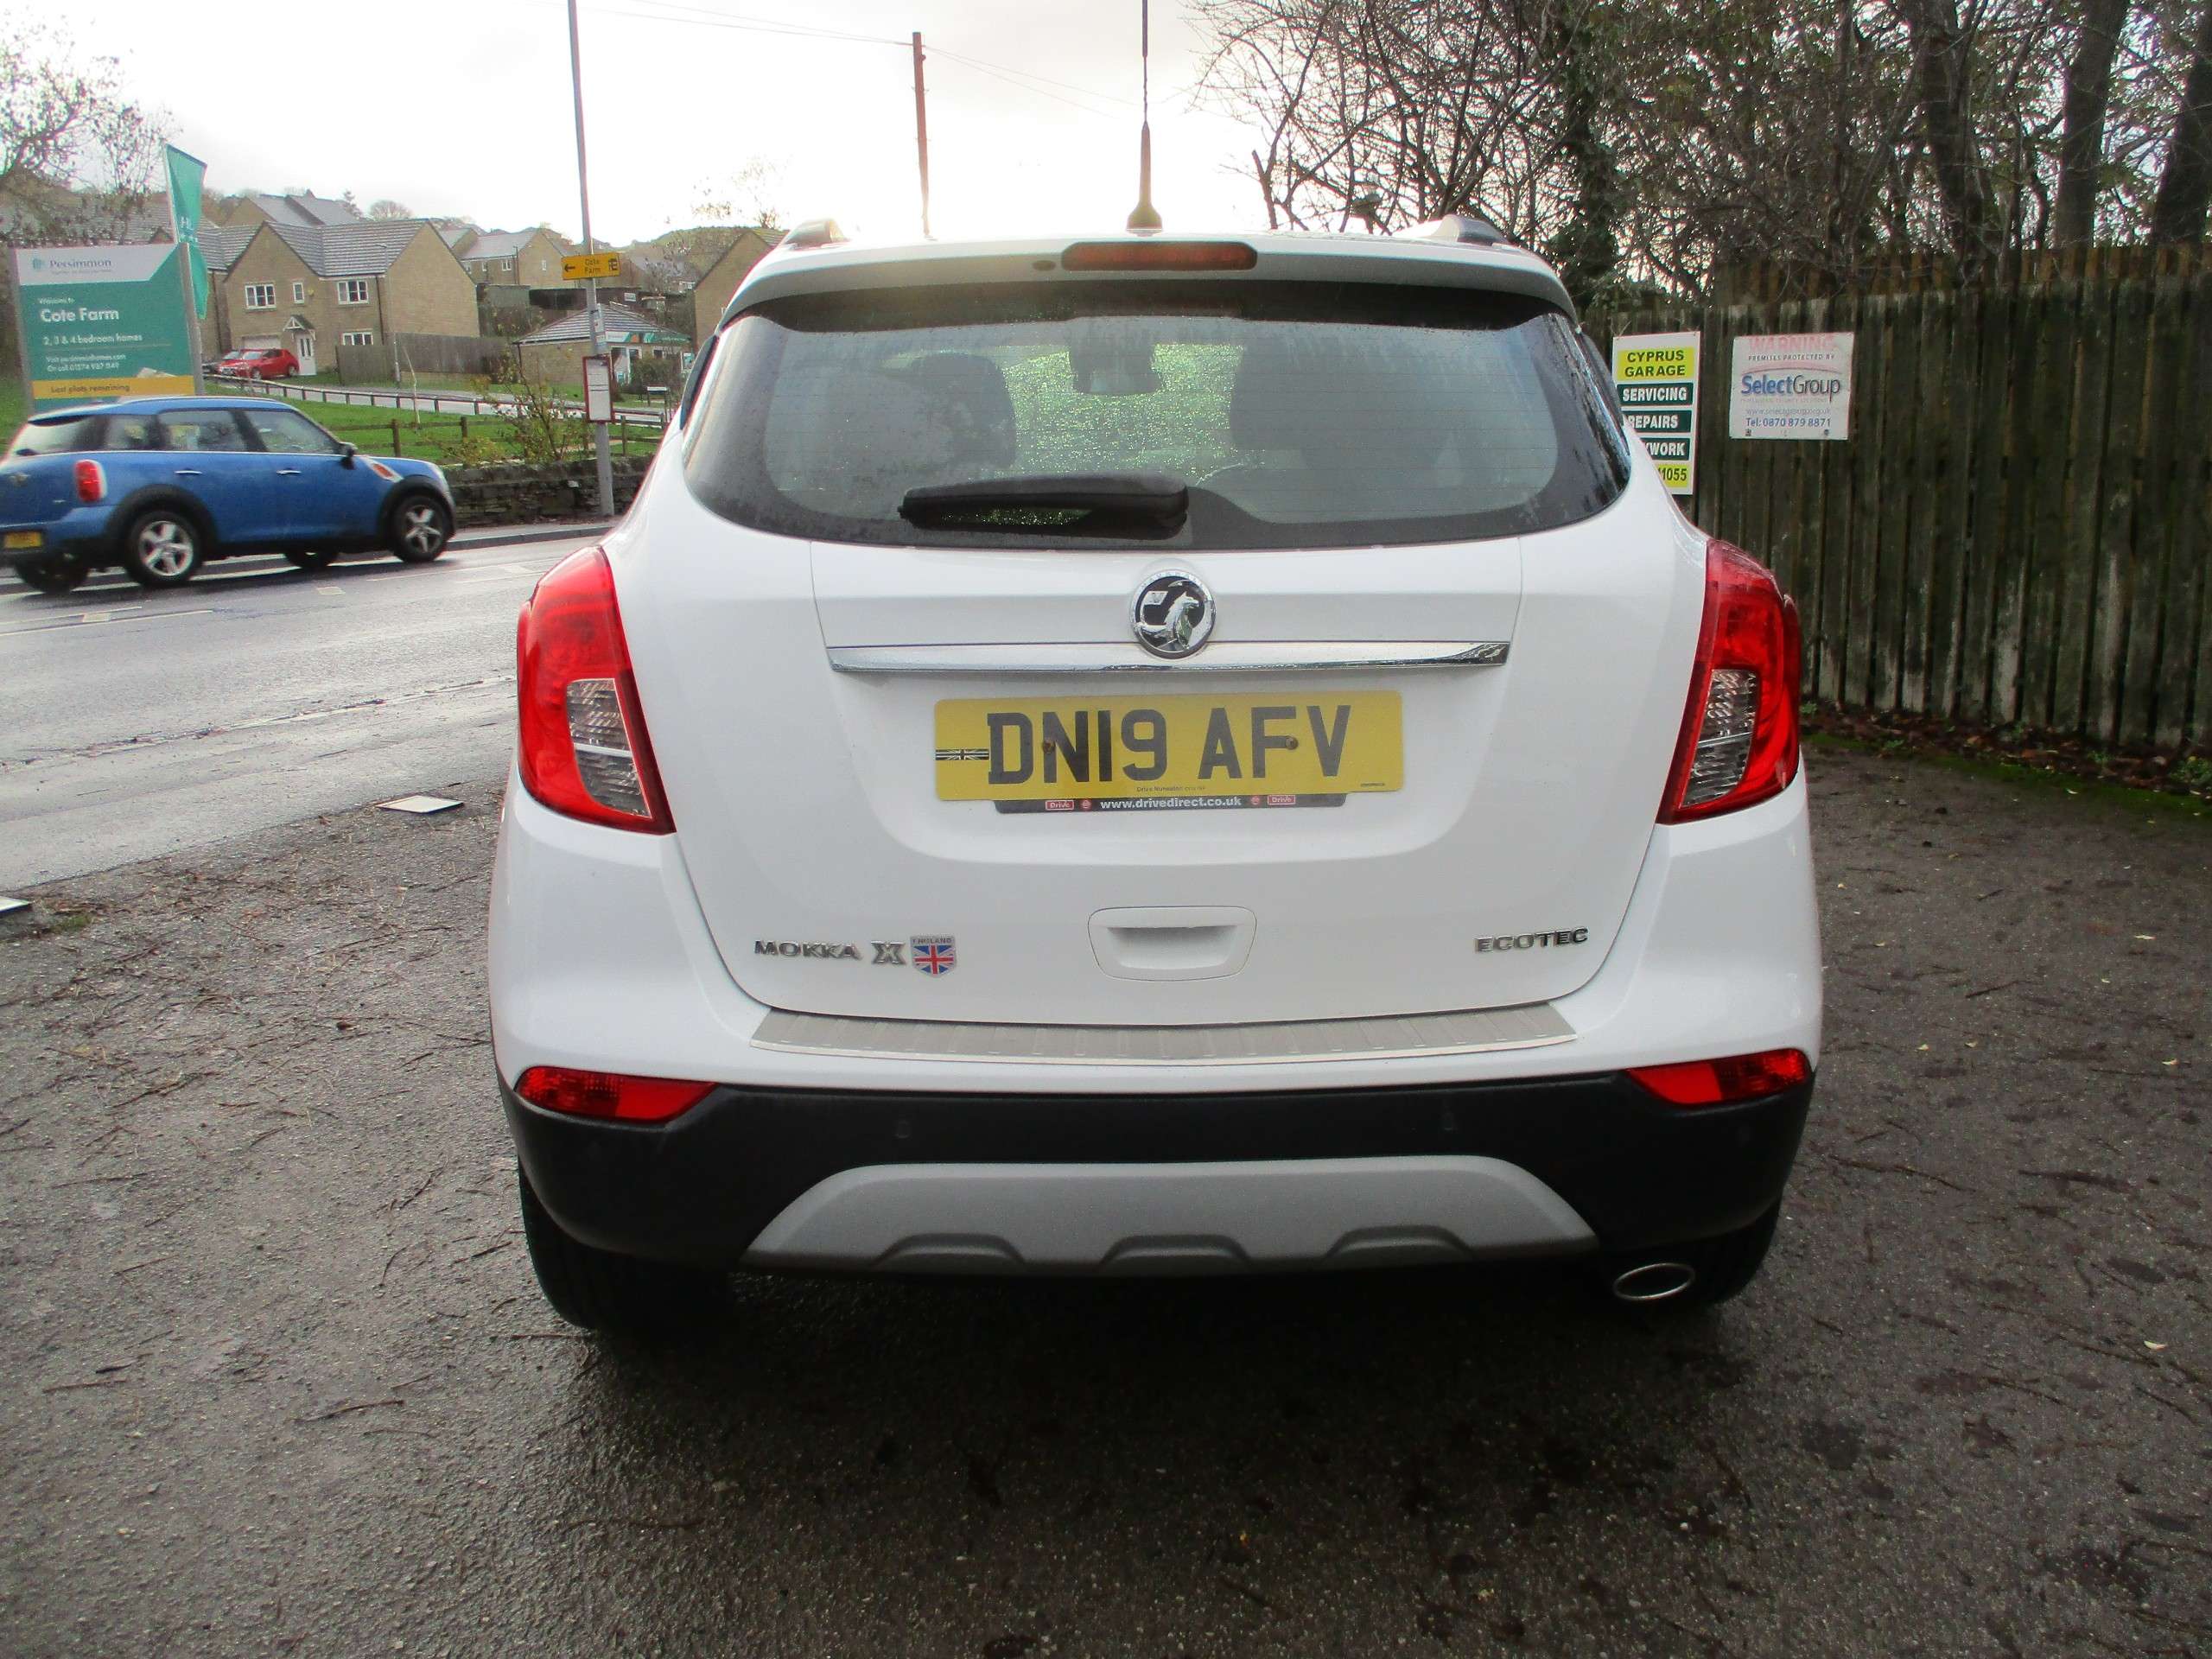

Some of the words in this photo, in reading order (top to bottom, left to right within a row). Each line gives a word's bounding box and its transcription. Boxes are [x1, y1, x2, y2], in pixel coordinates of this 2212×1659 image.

[49, 259, 111, 268] Persimmon
[41, 308, 76, 322] Cote
[79, 308, 119, 321] Farm
[61, 335, 69, 344] &
[77, 334, 115, 344] bedroom
[116, 333, 143, 341] homes
[1627, 350, 1684, 363] CYPRUS
[1624, 365, 1686, 377] GARAGE
[89, 384, 130, 392] remaining
[1622, 386, 1687, 402] SERVICING
[1741, 375, 1840, 403] SelectGroup
[1628, 415, 1678, 429] REPAIRS
[1789, 418, 1806, 427] 879
[1808, 418, 1831, 427] 8871
[988, 707, 1167, 785] DN19
[1198, 704, 1351, 780] AFV
[1100, 797, 1242, 810] www.drivedirect.co.uk
[1474, 926, 1588, 954] ECOTEC
[754, 939, 863, 961] MOKKA
[870, 940, 907, 965] X
